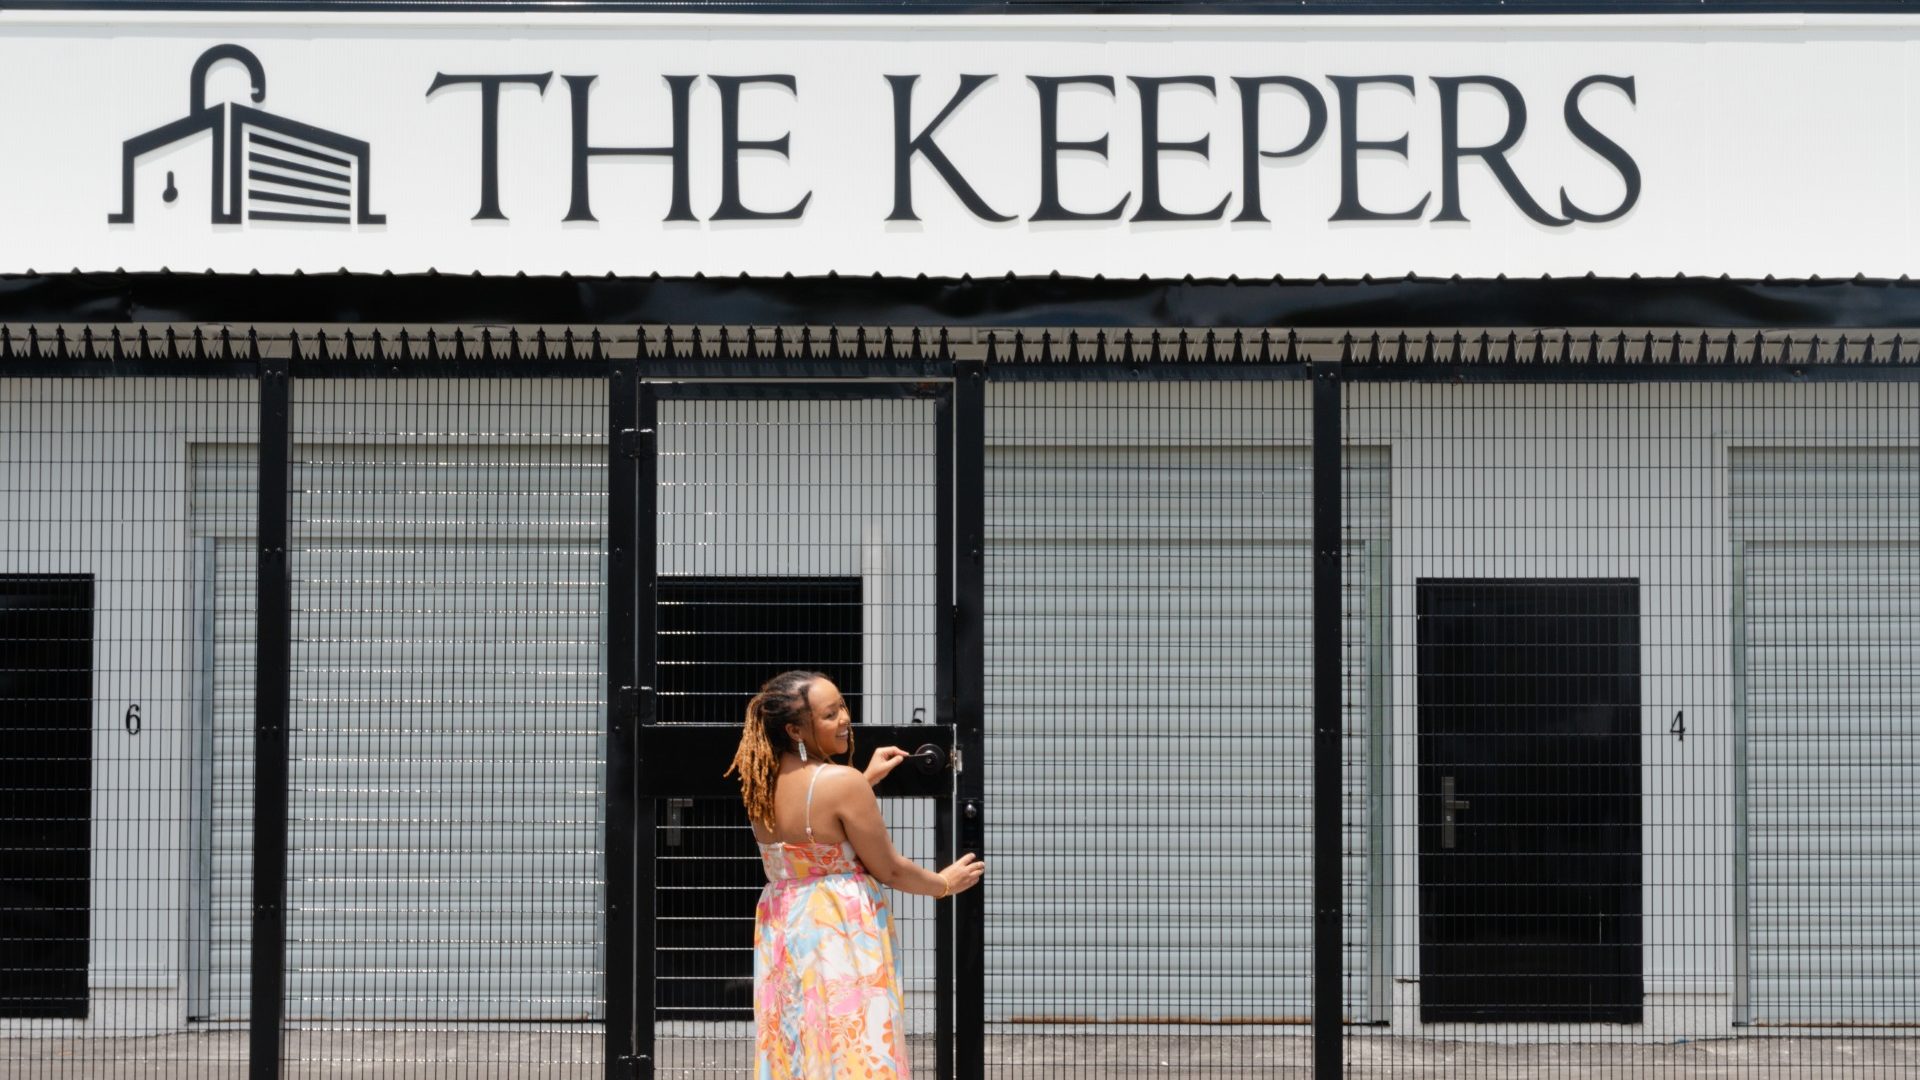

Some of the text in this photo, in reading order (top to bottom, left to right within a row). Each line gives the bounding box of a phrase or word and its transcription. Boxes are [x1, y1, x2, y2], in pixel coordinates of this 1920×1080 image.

[426, 71, 1641, 227] THE KEEPERS
[126, 704, 141, 736] 6
[1669, 710, 1686, 742] 4
